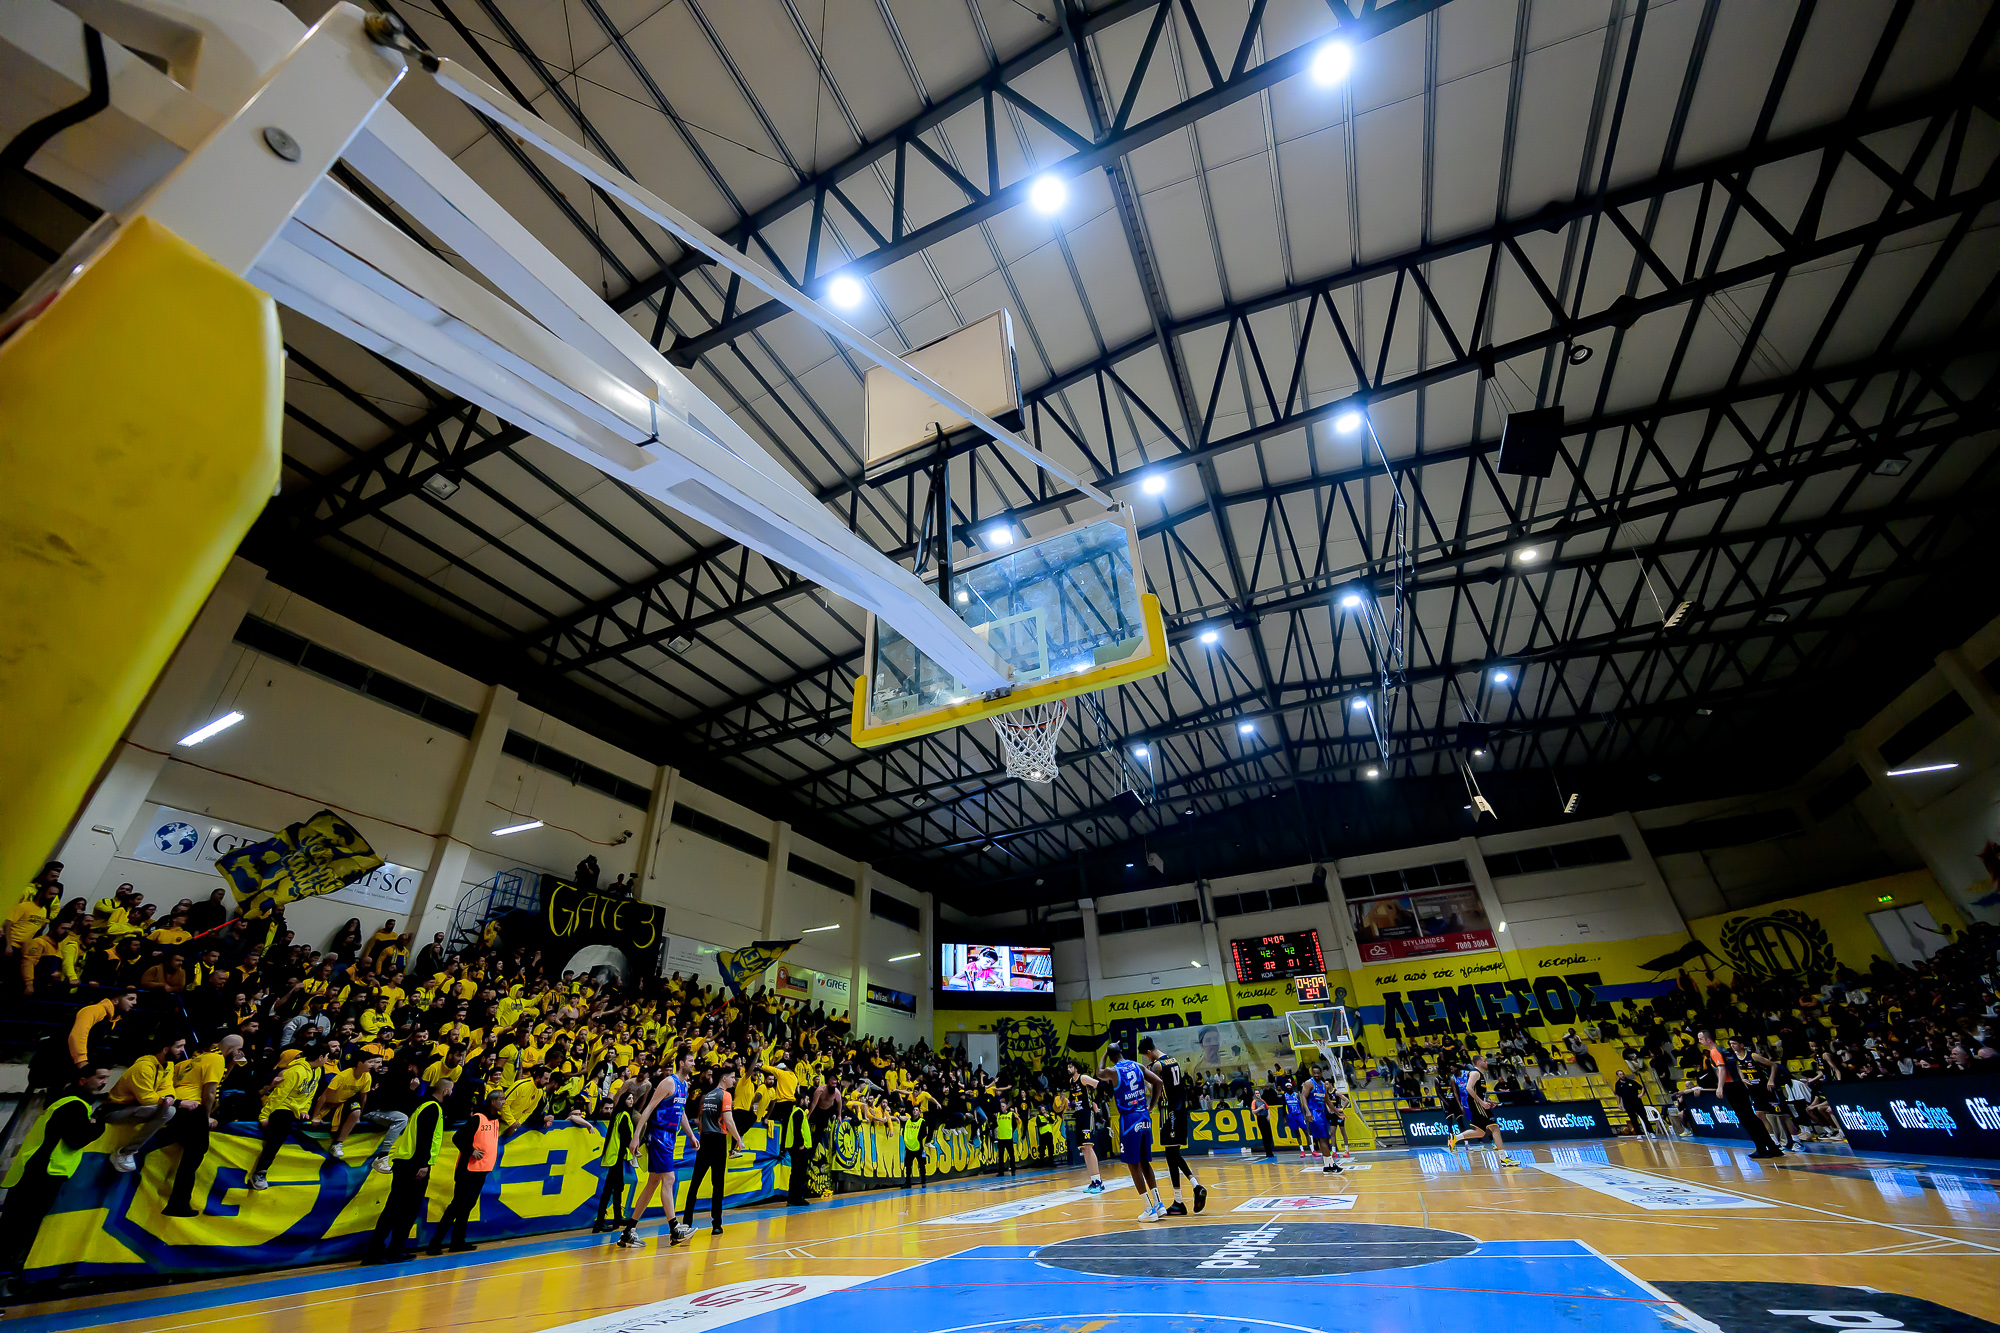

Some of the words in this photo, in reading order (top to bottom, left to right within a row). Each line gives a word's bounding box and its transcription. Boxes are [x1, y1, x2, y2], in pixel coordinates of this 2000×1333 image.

[549, 881, 631, 937] GATE
[632, 900, 656, 948] 3
[1402, 936, 1446, 947] STYLIANIDES
[1455, 940, 1472, 949] 7000
[1472, 939, 1489, 948] 3004
[1260, 949, 1271, 958] 42
[1284, 946, 1295, 955] 42
[826, 977, 848, 992] GREE
[1296, 976, 1326, 989] 04:09
[1305, 988, 1320, 999] 24
[1161, 998, 1174, 1008] τη
[1126, 1070, 1139, 1091] 2
[1171, 1066, 1180, 1086] 17
[1539, 1112, 1596, 1131] OfficeSteps
[1835, 1103, 1889, 1137] OfficeSteps
[1889, 1099, 1957, 1136] OfficeSteps
[480, 1124, 492, 1132] 323
